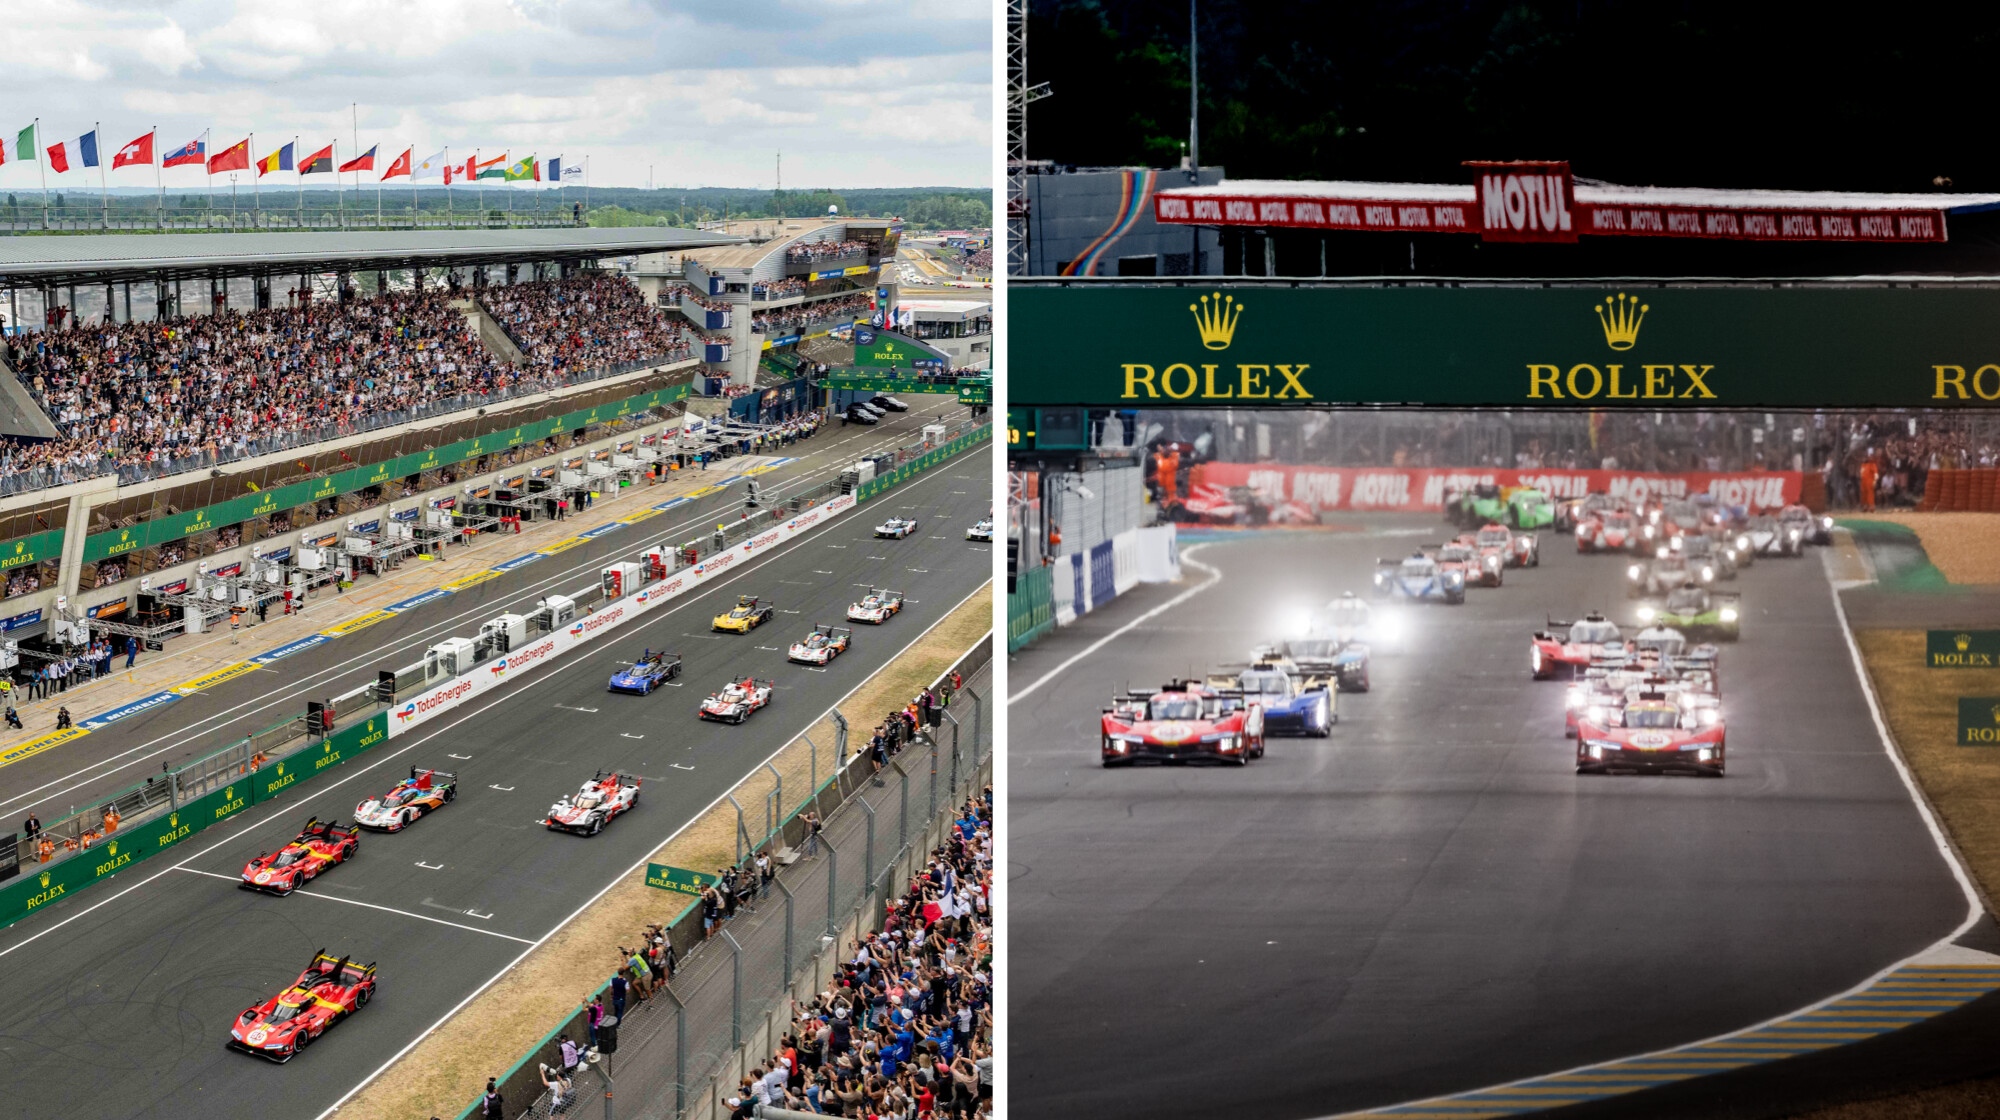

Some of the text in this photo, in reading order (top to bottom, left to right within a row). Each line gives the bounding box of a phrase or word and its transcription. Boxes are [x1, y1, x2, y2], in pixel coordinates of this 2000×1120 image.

[1159, 198, 1465, 228] MOTUL MOTUL MOTUL MOTUL MOTUL MOTUL MOTUL MOTUL MOTUL
[1483, 174, 1571, 231] MOTUL
[1593, 209, 1934, 238] MOTUL MOTUL MOTUL MOTUL MOTUL MOTUL MOTUL MOTUL MOTUL
[1120, 363, 2000, 400] ROLEX ROLEX RO
[315, 487, 336, 499] ROLEX
[1350, 473, 1411, 506] MOTUL
[253, 502, 277, 515] ROLEX
[185, 520, 211, 534] ROLEX
[108, 540, 137, 554] ROLEX
[1, 553, 34, 569] ROLEX
[648, 577, 683, 601] TotalEnergies
[342, 612, 389, 631] MICHELIN
[583, 606, 624, 633] TotalEnergies
[273, 636, 325, 658] MICHELIN
[507, 640, 554, 670] TotalEnergies
[1934, 653, 1991, 666] ROLEX
[196, 663, 251, 686] MICHELIN
[106, 693, 173, 721] MICHELIN
[416, 680, 472, 714] TotalEnergies
[4, 729, 78, 760] MICHELIN
[316, 751, 341, 769] ROLEX
[268, 773, 295, 793] ROLEX
[216, 797, 244, 818] ROLEX
[159, 823, 191, 847] ROLEX
[96, 851, 131, 877] ROLEX
[648, 877, 678, 889] ROLEX
